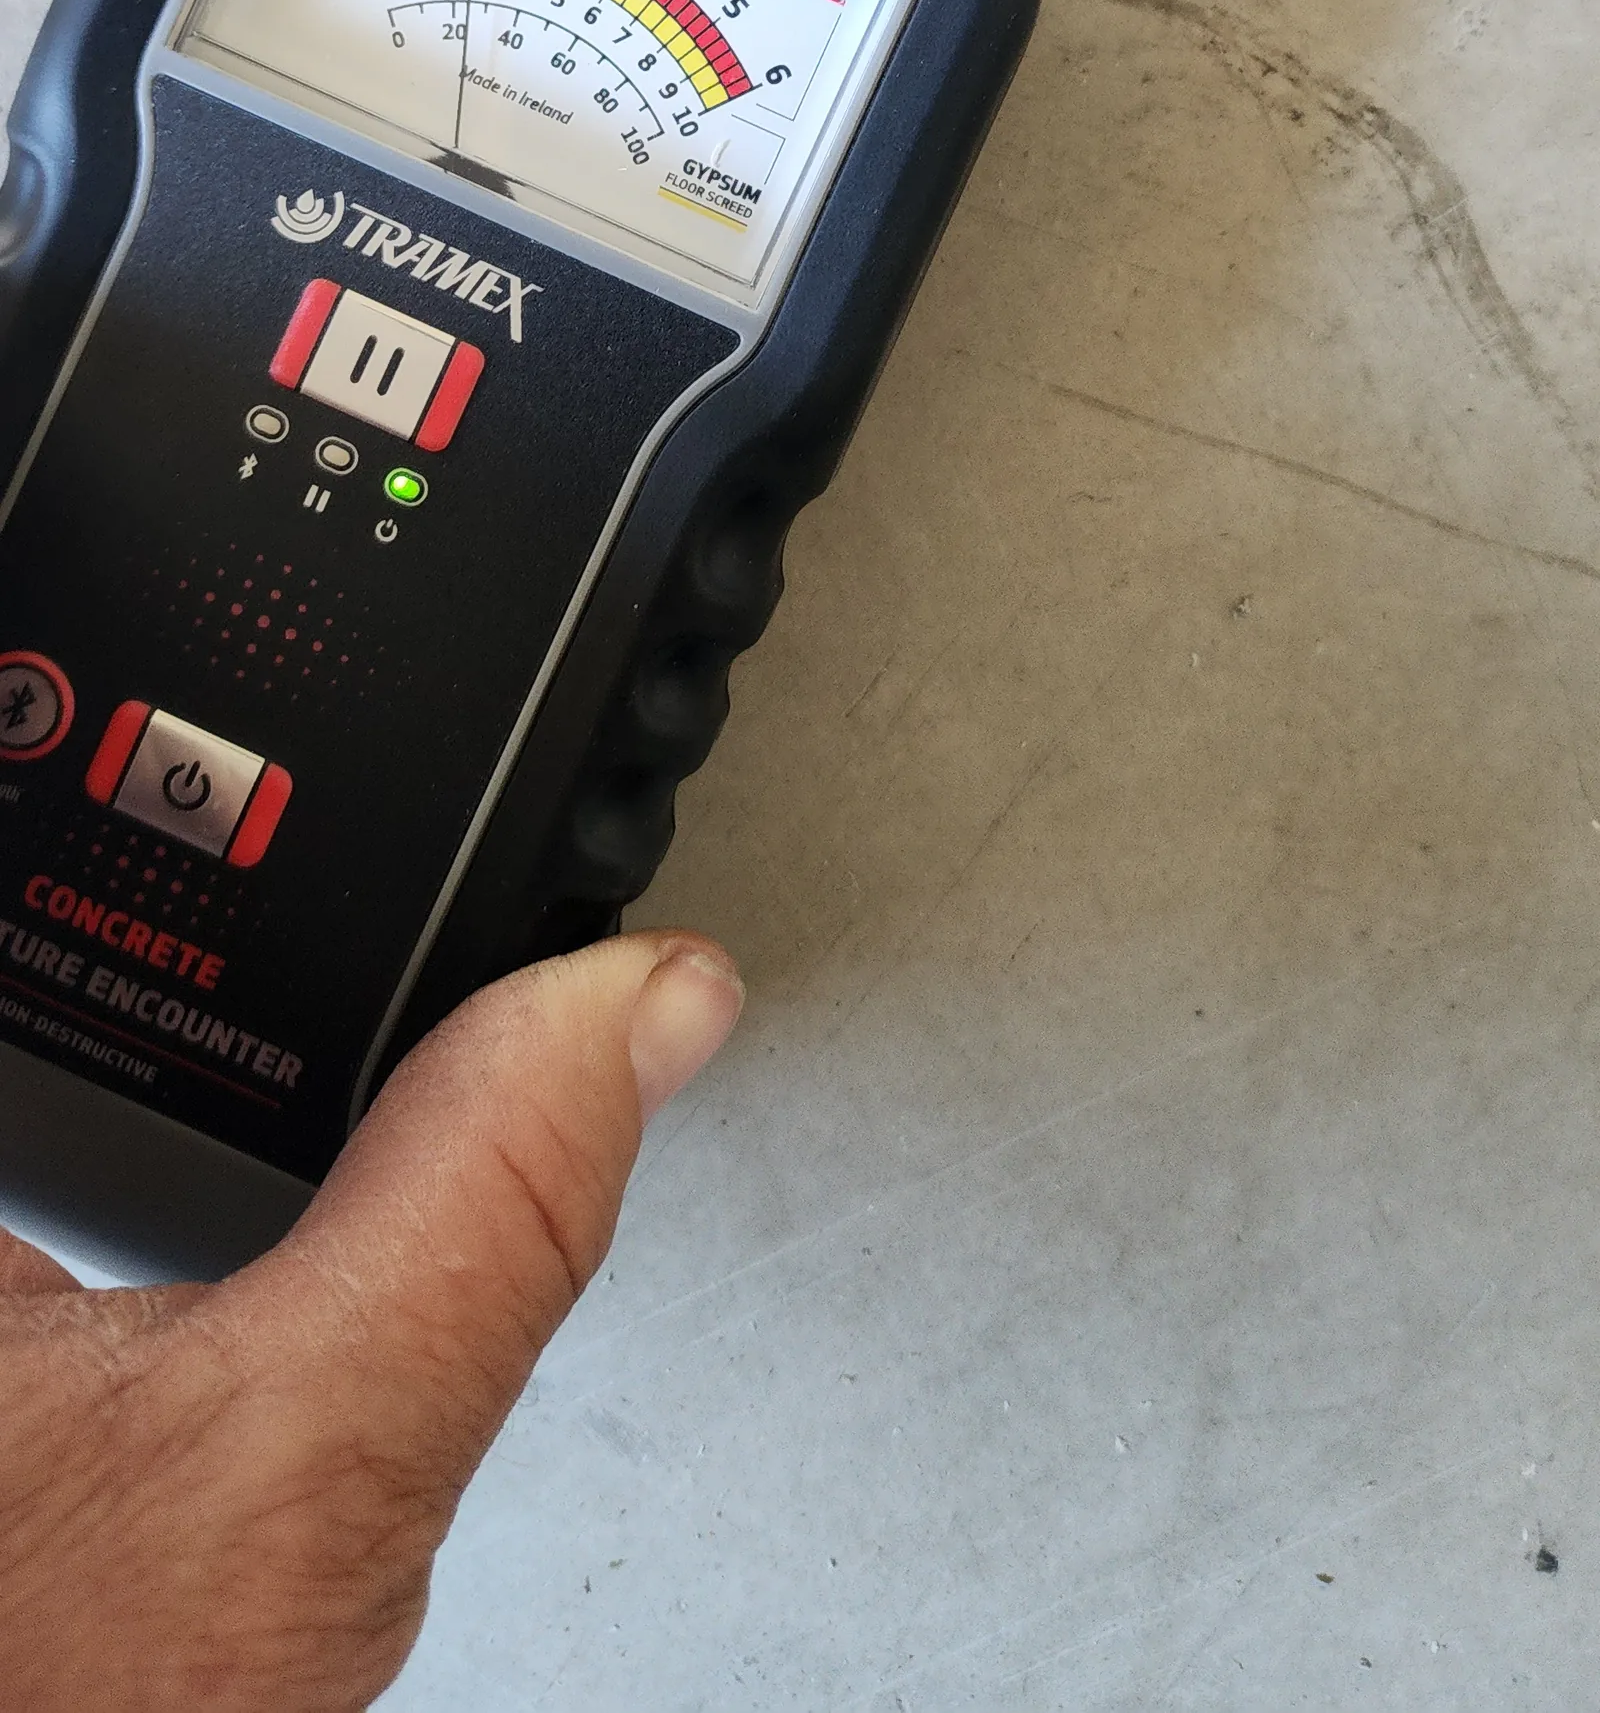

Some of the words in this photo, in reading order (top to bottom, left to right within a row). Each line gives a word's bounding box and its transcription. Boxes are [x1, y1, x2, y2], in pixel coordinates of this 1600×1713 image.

[392, 31, 406, 49] 0
[442, 24, 467, 41] 20
[498, 30, 524, 50] 40
[550, 51, 577, 76] 60
[593, 88, 619, 114] 80
[620, 125, 650, 166] 100
[458, 64, 501, 94] Made
[502, 84, 518, 101] in
[518, 90, 574, 125] Ireland
[583, 6, 602, 25] 6
[612, 26, 633, 45] 7
[637, 53, 658, 72] 8
[658, 82, 679, 99] 9
[671, 106, 699, 137] 10
[765, 63, 792, 86] 6
[664, 171, 706, 198] FLOOR
[705, 190, 753, 219] SCREED
[683, 158, 763, 205] GYPSUM
[342, 202, 546, 344] TRAMEX
[24, 874, 227, 991] CONCRETE
[85, 964, 304, 1088] ENCOUNTER
